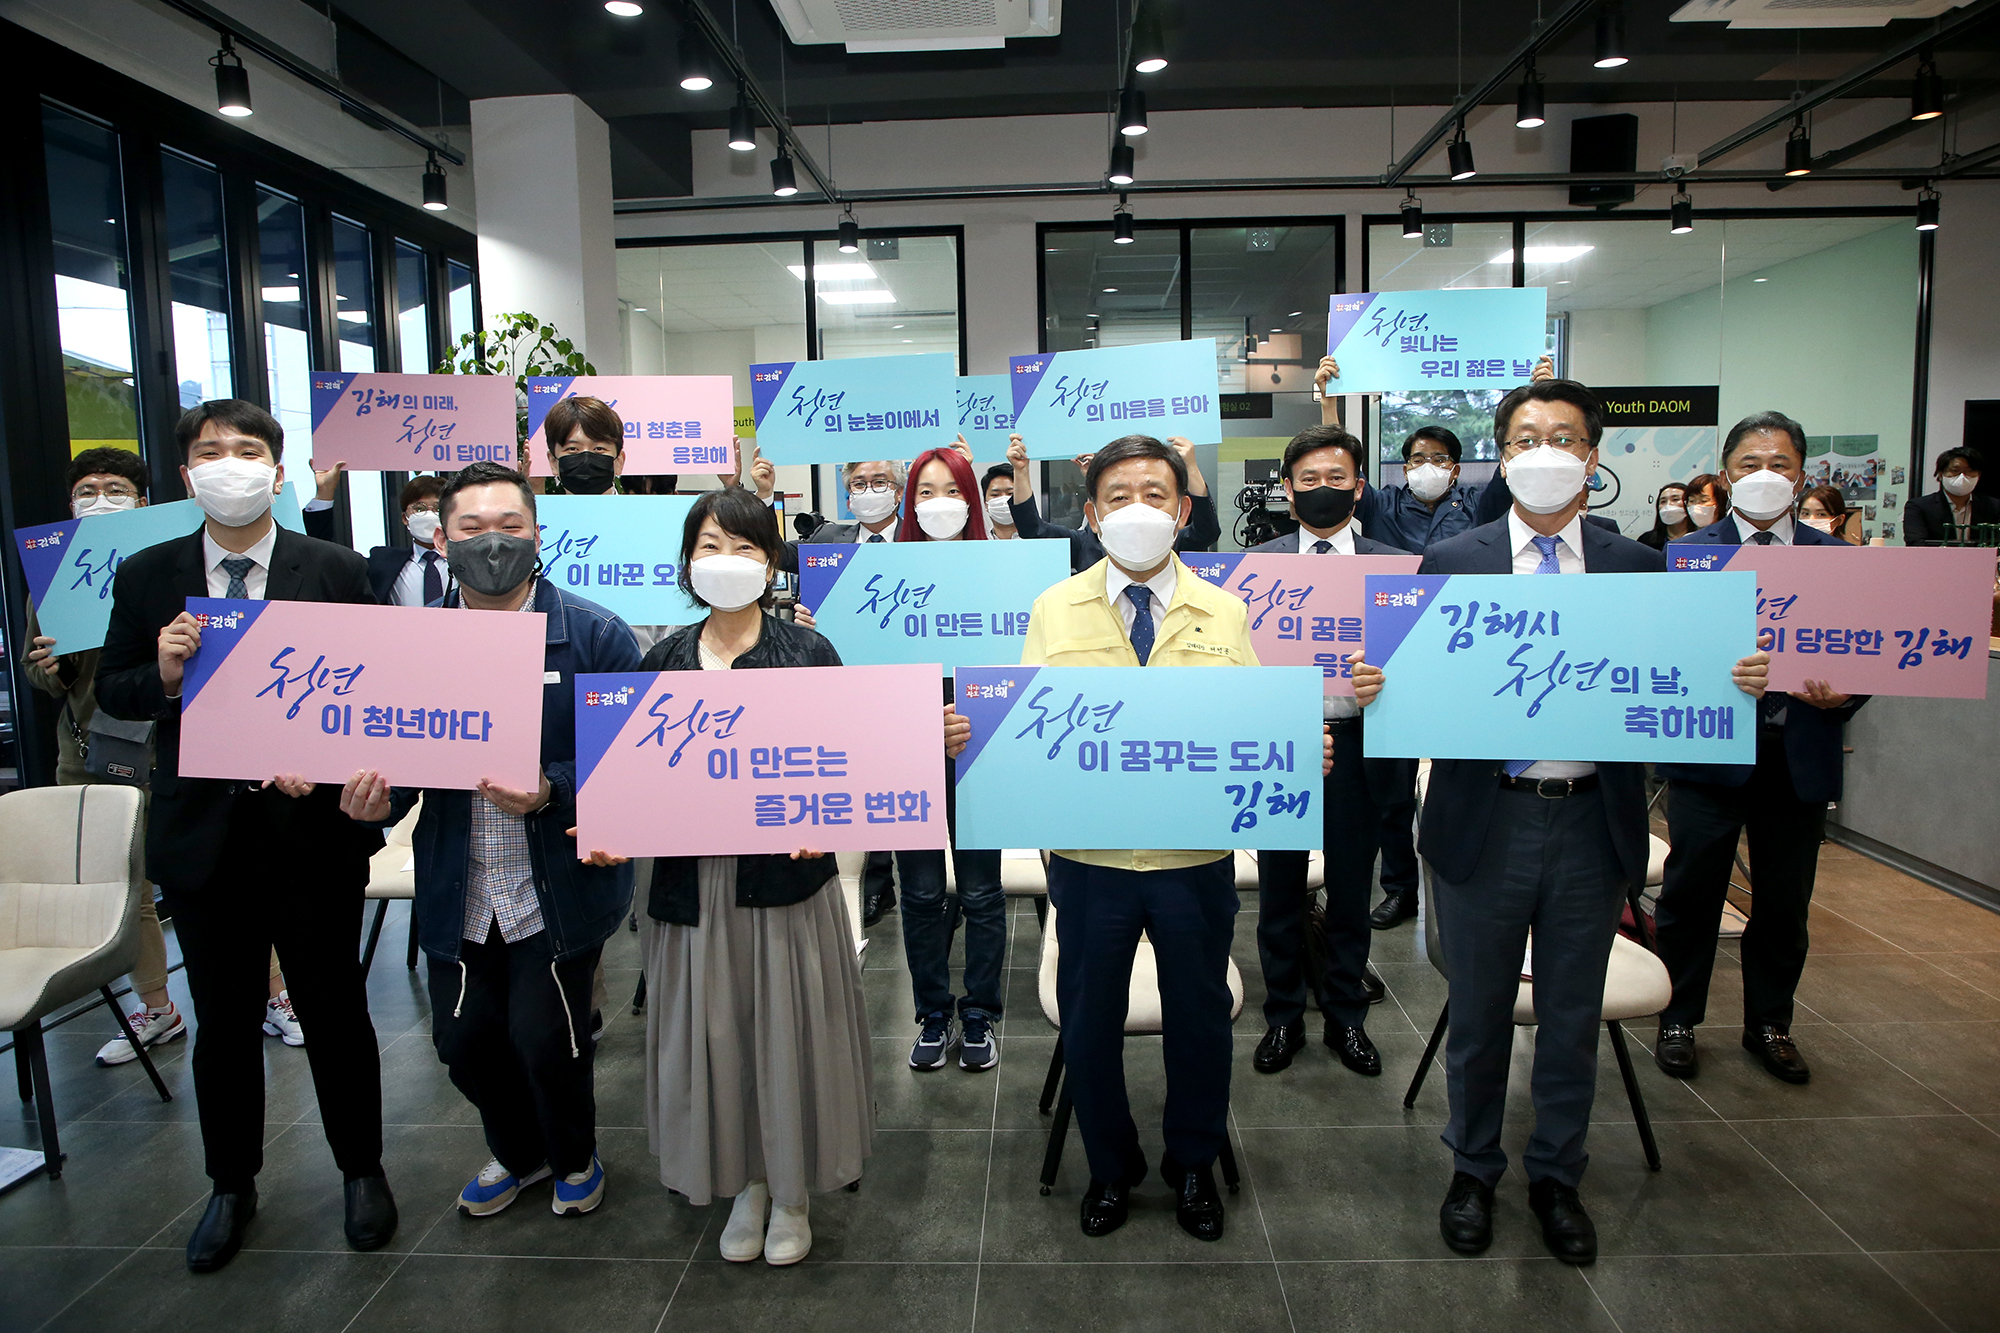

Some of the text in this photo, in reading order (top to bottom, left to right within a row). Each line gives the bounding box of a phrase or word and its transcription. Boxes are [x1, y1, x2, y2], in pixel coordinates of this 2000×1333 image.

[1400, 334, 1458, 354] 빛나는
[1420, 359, 1533, 379] 우리 젊은 날
[423, 395, 459, 412] 미래,
[786, 385, 846, 428] 청년
[1049, 375, 1110, 418] 청년
[1086, 394, 1210, 422] 의 마음을 담아
[1240, 402, 1251, 411] 02
[1606, 400, 1691, 414] Youth DAOM
[396, 414, 456, 454] 청년
[623, 421, 702, 439] 의 청춘을
[824, 409, 940, 433] 의 눈높이에서
[974, 415, 989, 430] 의
[433, 444, 511, 462] 이 답이다
[672, 446, 728, 464] 응원해
[70, 548, 124, 600] 청
[567, 563, 685, 587] 이 바꾼 오
[817, 556, 838, 568] 김해
[1198, 566, 1220, 578] 김해
[1688, 557, 1711, 570] 김해
[856, 573, 936, 630] 청년
[1237, 573, 1314, 631] 청년
[1389, 592, 1418, 607] 김해
[1756, 588, 1798, 620] 년
[210, 615, 237, 629] 김해
[904, 614, 927, 637] 이
[935, 612, 983, 637] 만든
[1278, 616, 1363, 642] 의 꿈을
[1440, 600, 1560, 654] 김해시
[1758, 627, 1973, 670] 이 당당한 김해
[256, 646, 366, 720] 청년
[980, 684, 1008, 699] 김해
[1650, 666, 1689, 697] 날,
[600, 691, 628, 706] 김해
[321, 704, 494, 742] 이 청년하다
[635, 693, 745, 768] 청년
[1015, 686, 1125, 760] 청년
[1624, 705, 1734, 740] 축하해
[707, 746, 848, 779] 이 만드는
[1078, 740, 1294, 773] 이 꿈꾸는 도시
[754, 790, 932, 827] 즐거운 변화
[1224, 780, 1311, 834] 김해
